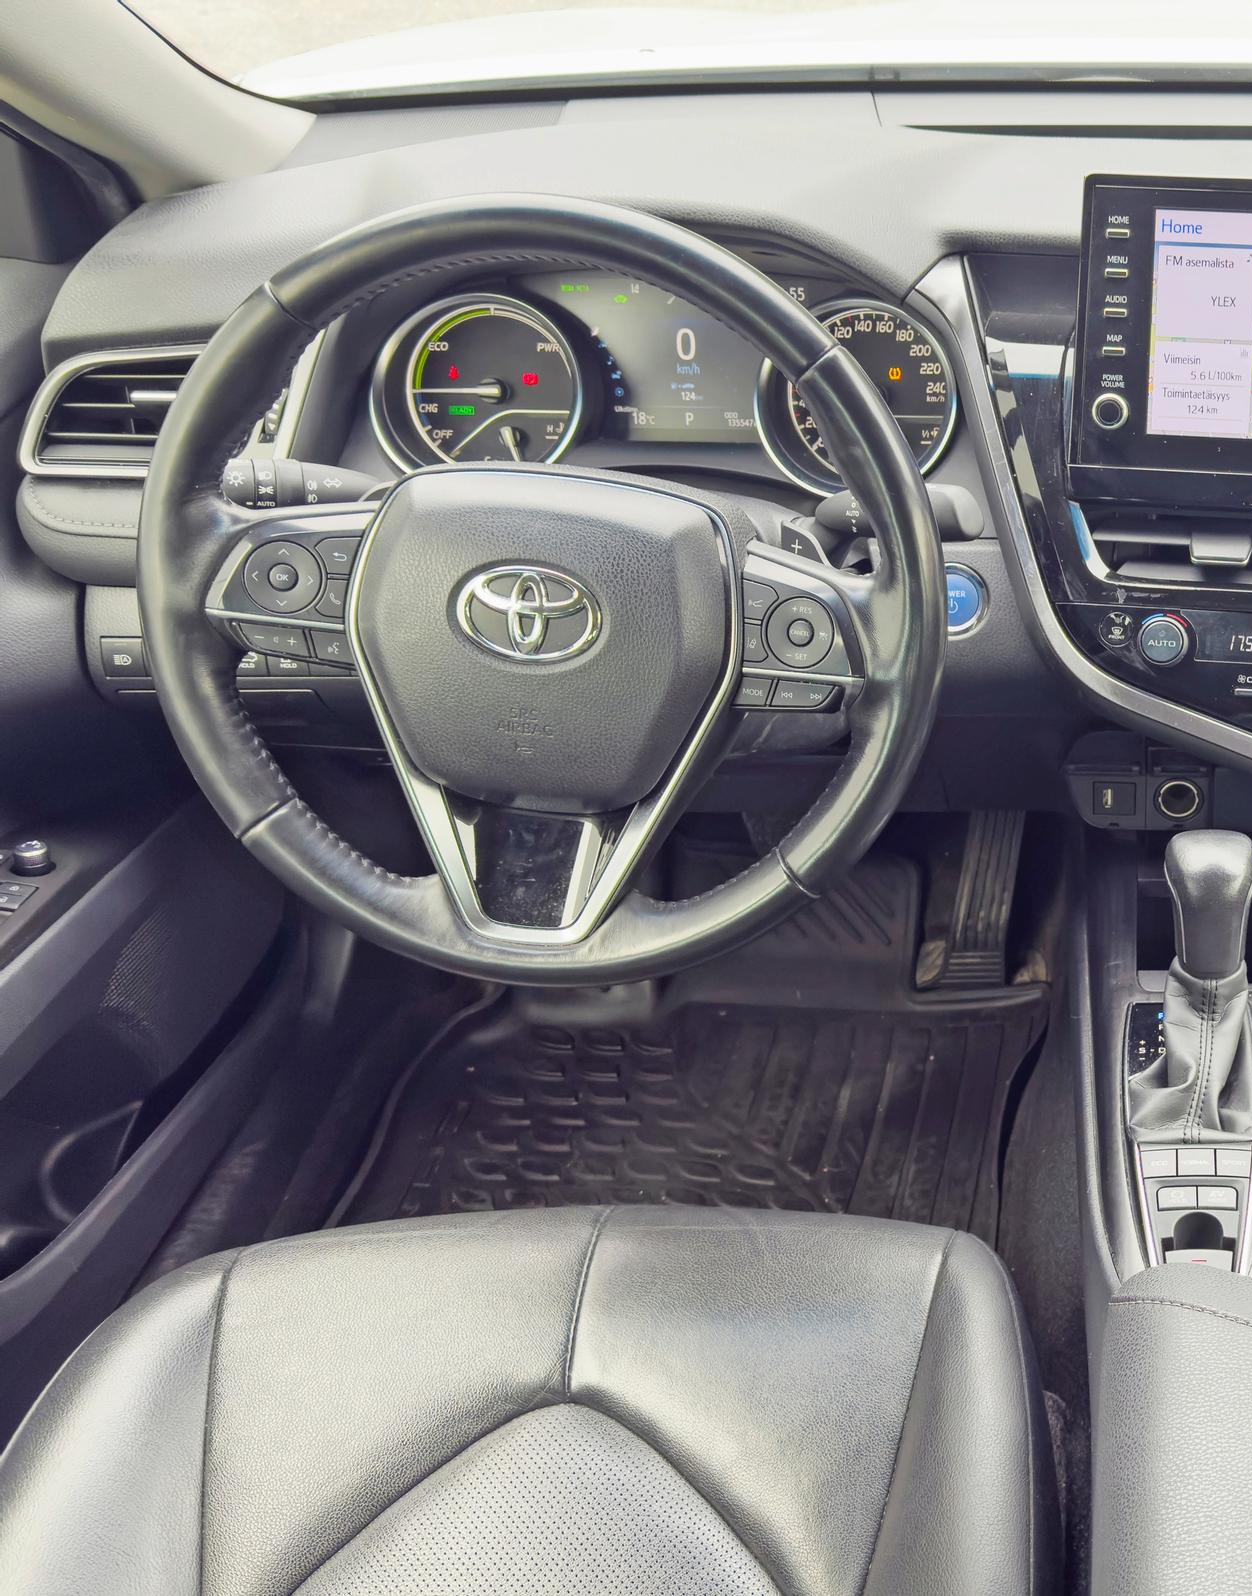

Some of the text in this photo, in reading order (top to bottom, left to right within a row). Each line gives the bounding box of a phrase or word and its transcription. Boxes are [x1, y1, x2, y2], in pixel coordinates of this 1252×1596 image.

[1108, 216, 1129, 224] HOME
[1161, 219, 1203, 234] Home
[1107, 256, 1128, 264] MENU
[1165, 255, 1234, 269] FM asemalista
[789, 288, 805, 300] 55
[1105, 295, 1127, 303] AUDIO
[1211, 296, 1236, 308] YLEX
[855, 320, 872, 332] 140
[876, 321, 894, 333] 160
[835, 327, 852, 339] 120
[896, 330, 914, 341] 180
[428, 342, 449, 352] ECO
[537, 342, 560, 352] PWR
[676, 328, 696, 361] 0
[909, 345, 932, 357] 200
[1163, 354, 1201, 365] Viimeisin
[677, 364, 700, 375] km/h
[920, 363, 941, 375] 220
[1190, 371, 1242, 382] 56 L/100km
[681, 392, 696, 401] 124
[926, 395, 945, 403] km/h
[1163, 388, 1230, 402] Toimintaetäisyys
[419, 404, 438, 413] CHG
[1187, 404, 1218, 415] 124 km
[685, 412, 694, 426] P
[433, 430, 453, 439] OFF
[276, 573, 289, 582] OK
[799, 606, 813, 615] RES
[1147, 639, 1177, 647] AUTO
[743, 688, 763, 697] MODE
